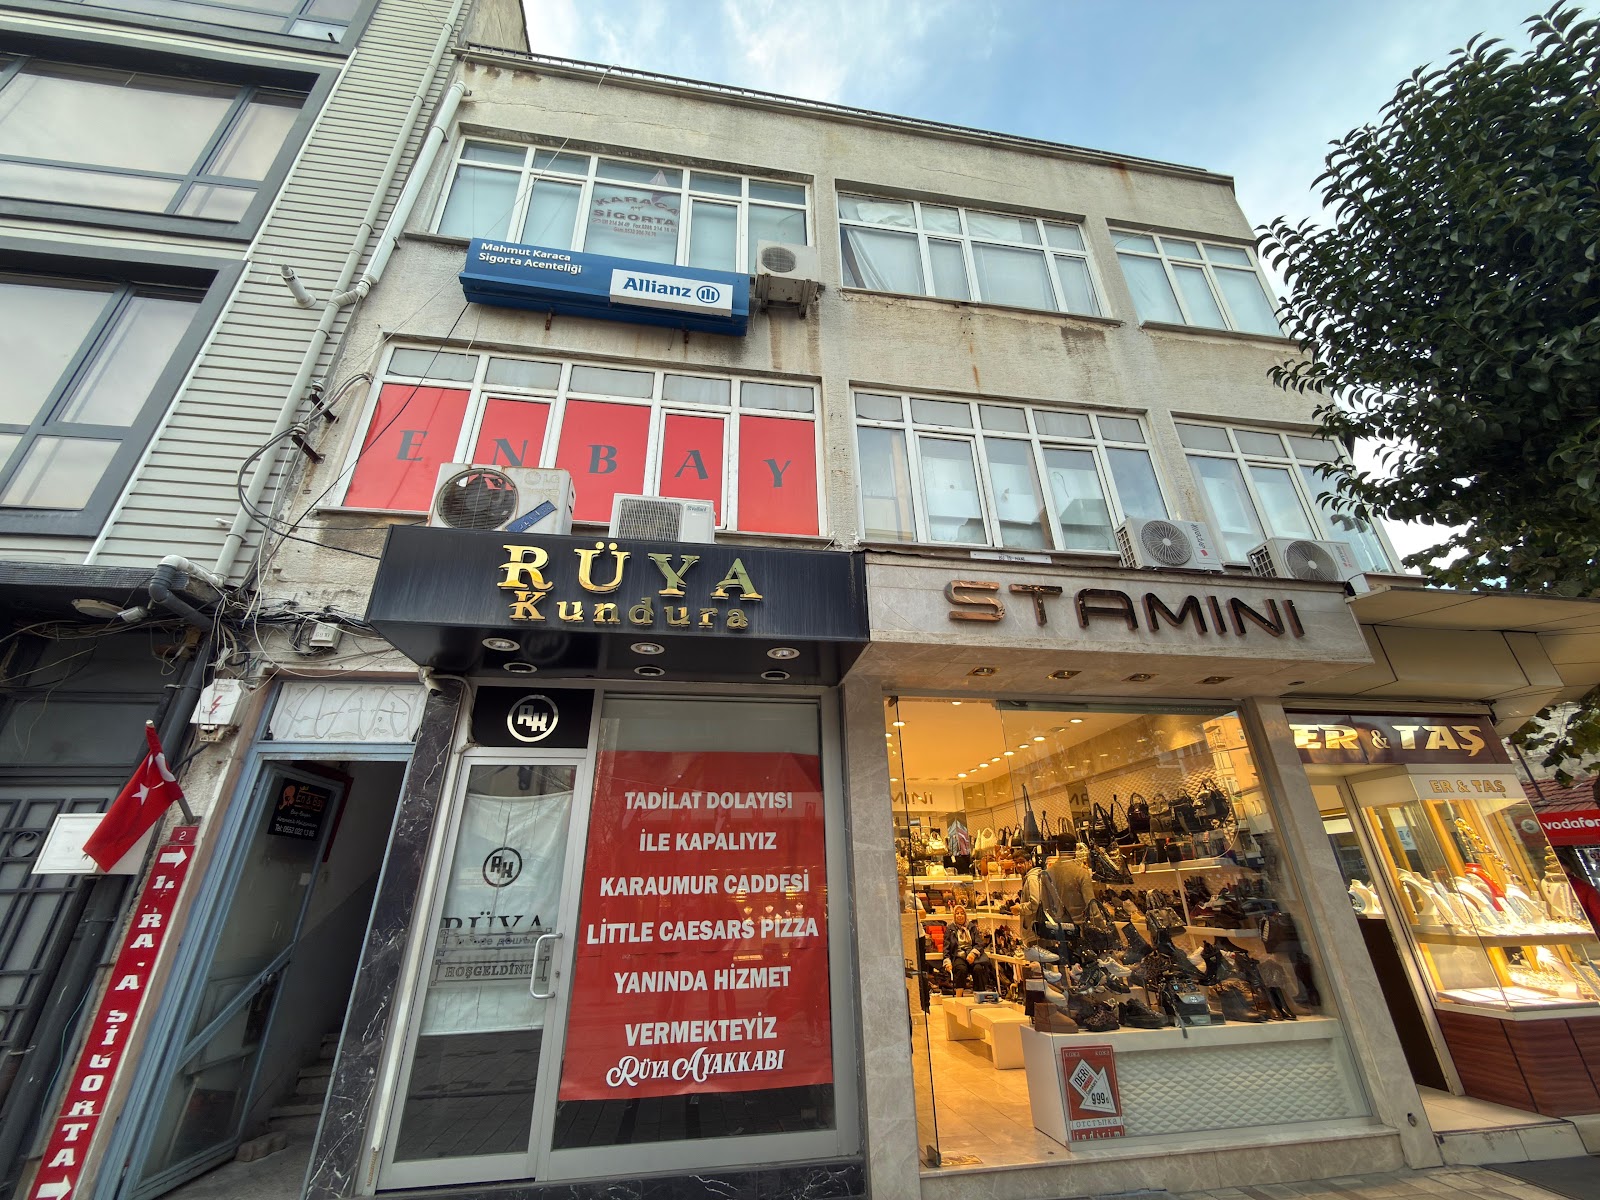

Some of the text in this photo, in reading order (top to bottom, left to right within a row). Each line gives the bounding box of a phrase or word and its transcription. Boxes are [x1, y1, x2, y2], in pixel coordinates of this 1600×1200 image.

[478, 252, 582, 275] Sigorta Acenteliği
[481, 241, 571, 262] Mahmut Karaca
[623, 276, 692, 298] Allianz
[497, 541, 763, 601] RÜYA
[508, 590, 749, 629] Kundura
[943, 579, 1305, 638] STAMINI
[1289, 724, 1485, 757] ER & TAŞ
[625, 787, 793, 810] TADİLAT DOLAYISI
[1429, 779, 1506, 798] ER & TAŞ
[179, 831, 186, 840] 2
[639, 828, 777, 851] İLE KAPALIYIZ
[600, 868, 809, 897] KARAUMUR CADDESİ
[586, 917, 819, 944] LİTTLE CAESARS PIZZA
[614, 963, 792, 994] YANINDA HİZMET
[625, 1011, 778, 1047] VERMEKTEYİZ
[1076, 1129, 1120, 1140] indirim
